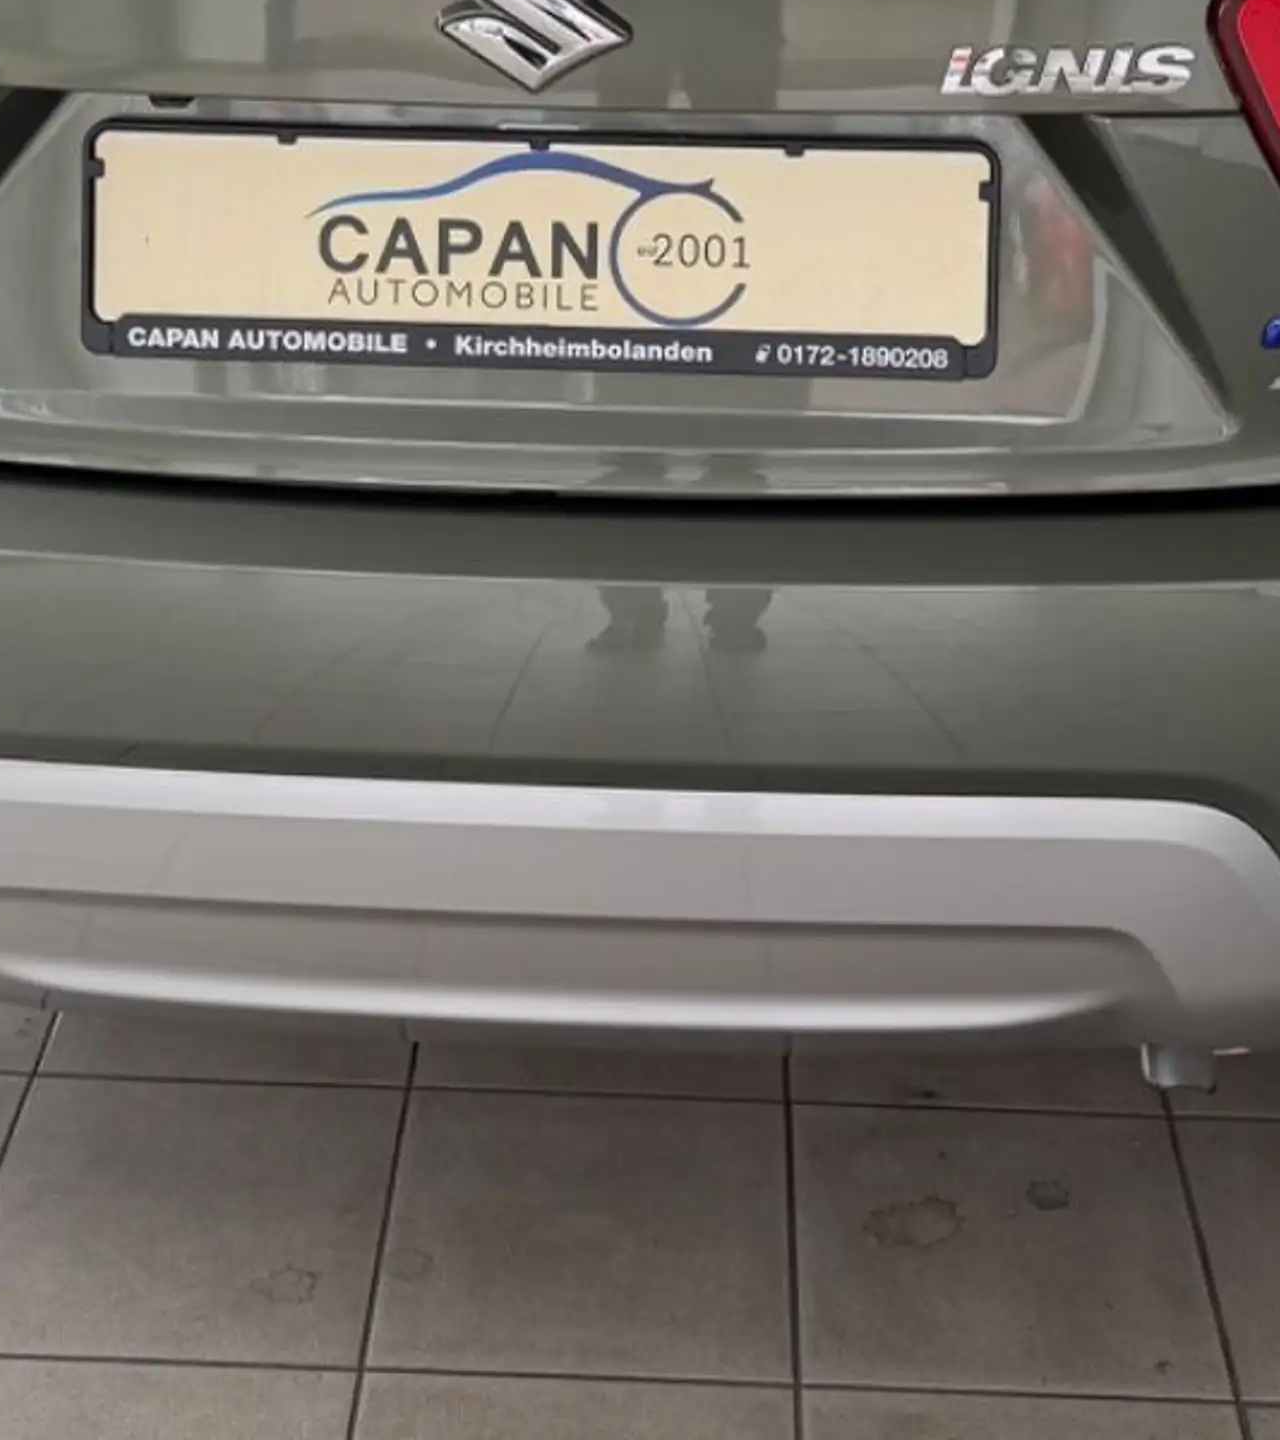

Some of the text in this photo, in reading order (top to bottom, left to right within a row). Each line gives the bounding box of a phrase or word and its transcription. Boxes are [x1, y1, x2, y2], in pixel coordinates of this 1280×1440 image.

[320, 215, 599, 280] CAPAN
[652, 232, 751, 269] 2001
[328, 277, 600, 312] AUTOMOBILE
[127, 325, 220, 350] CAPAN
[227, 328, 410, 355] AUTOMOBILE
[454, 334, 713, 363] Kirchheimbolanden
